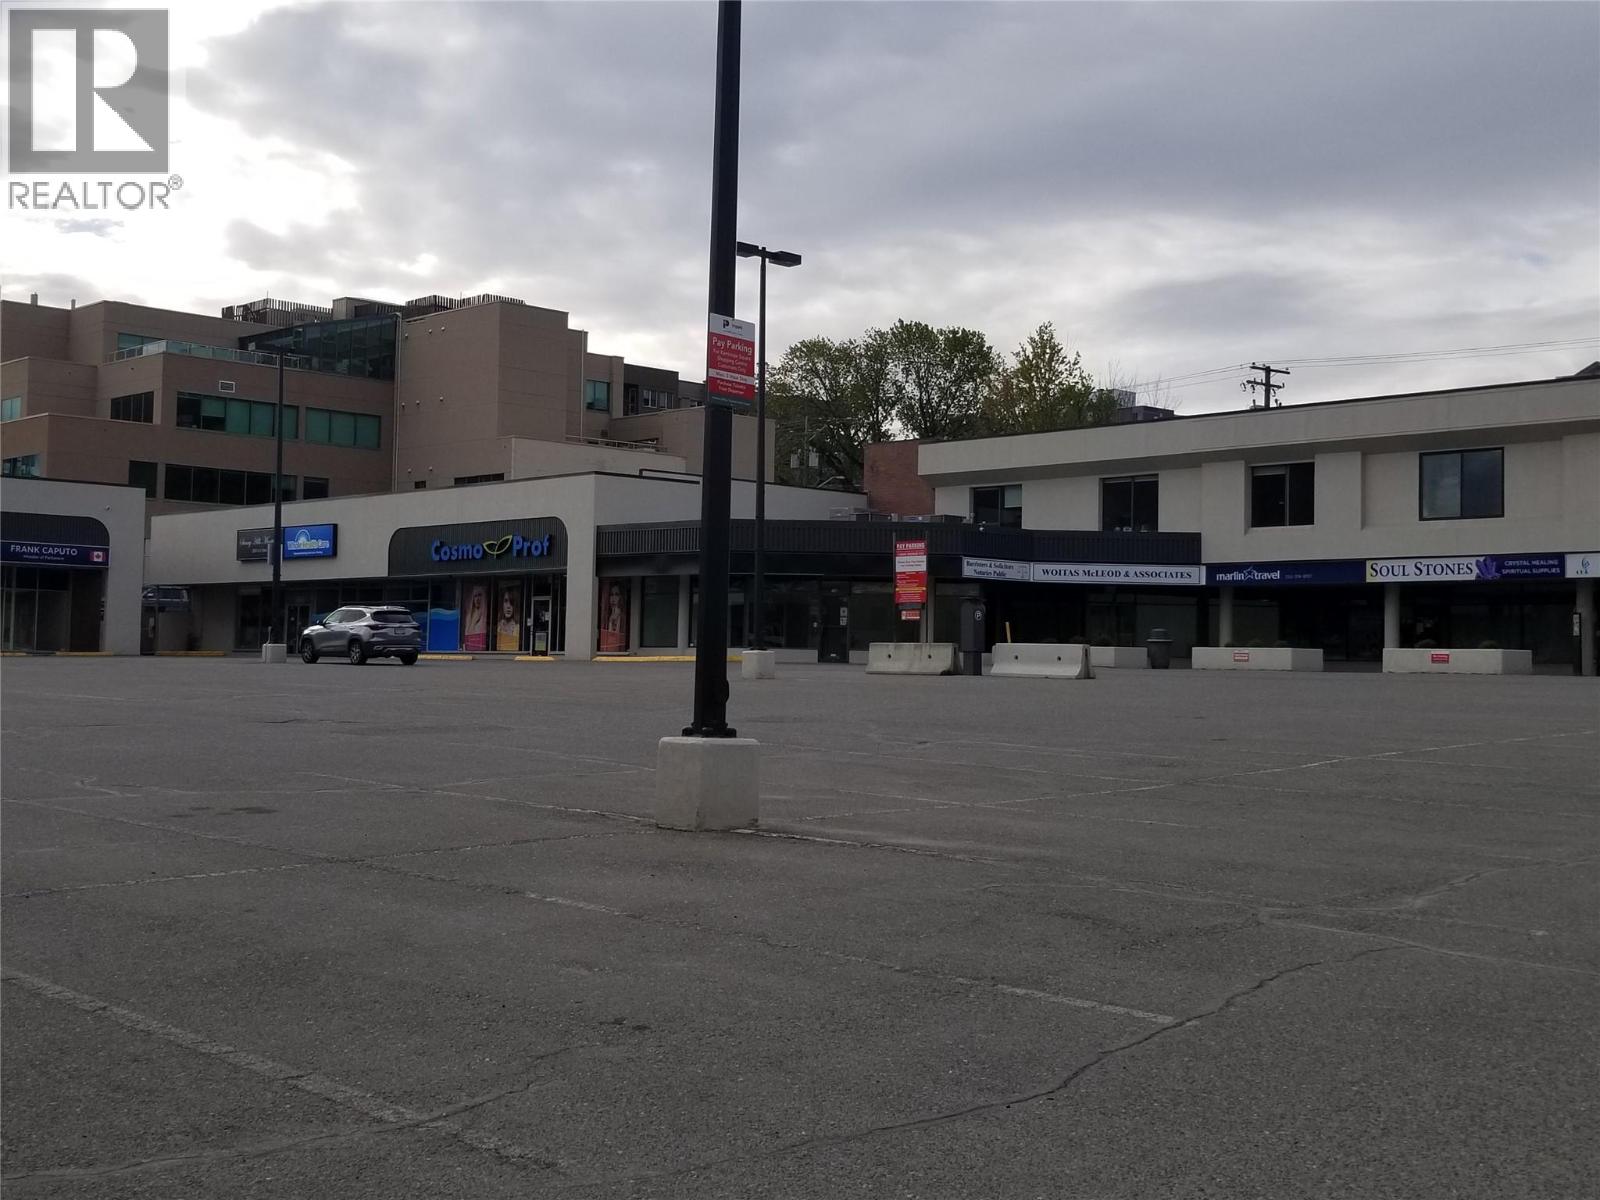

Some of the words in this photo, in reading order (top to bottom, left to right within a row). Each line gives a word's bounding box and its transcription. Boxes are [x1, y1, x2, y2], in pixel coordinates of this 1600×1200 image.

[712, 336, 725, 350] Pay
[726, 340, 753, 356] Parking
[10, 544, 40, 553] FRANK
[42, 547, 78, 556] CAPUTO
[431, 539, 483, 561] Cosmo
[512, 532, 551, 557] Prof
[1041, 568, 1080, 577] WOITAS
[1082, 569, 1122, 578] McLEOD
[1123, 570, 1130, 578] &
[1133, 570, 1192, 579] ASSOCIATES
[1216, 571, 1244, 581] marlin
[1254, 570, 1280, 580] travel
[1370, 562, 1410, 577] SOUL
[1413, 561, 1473, 577] STONES
